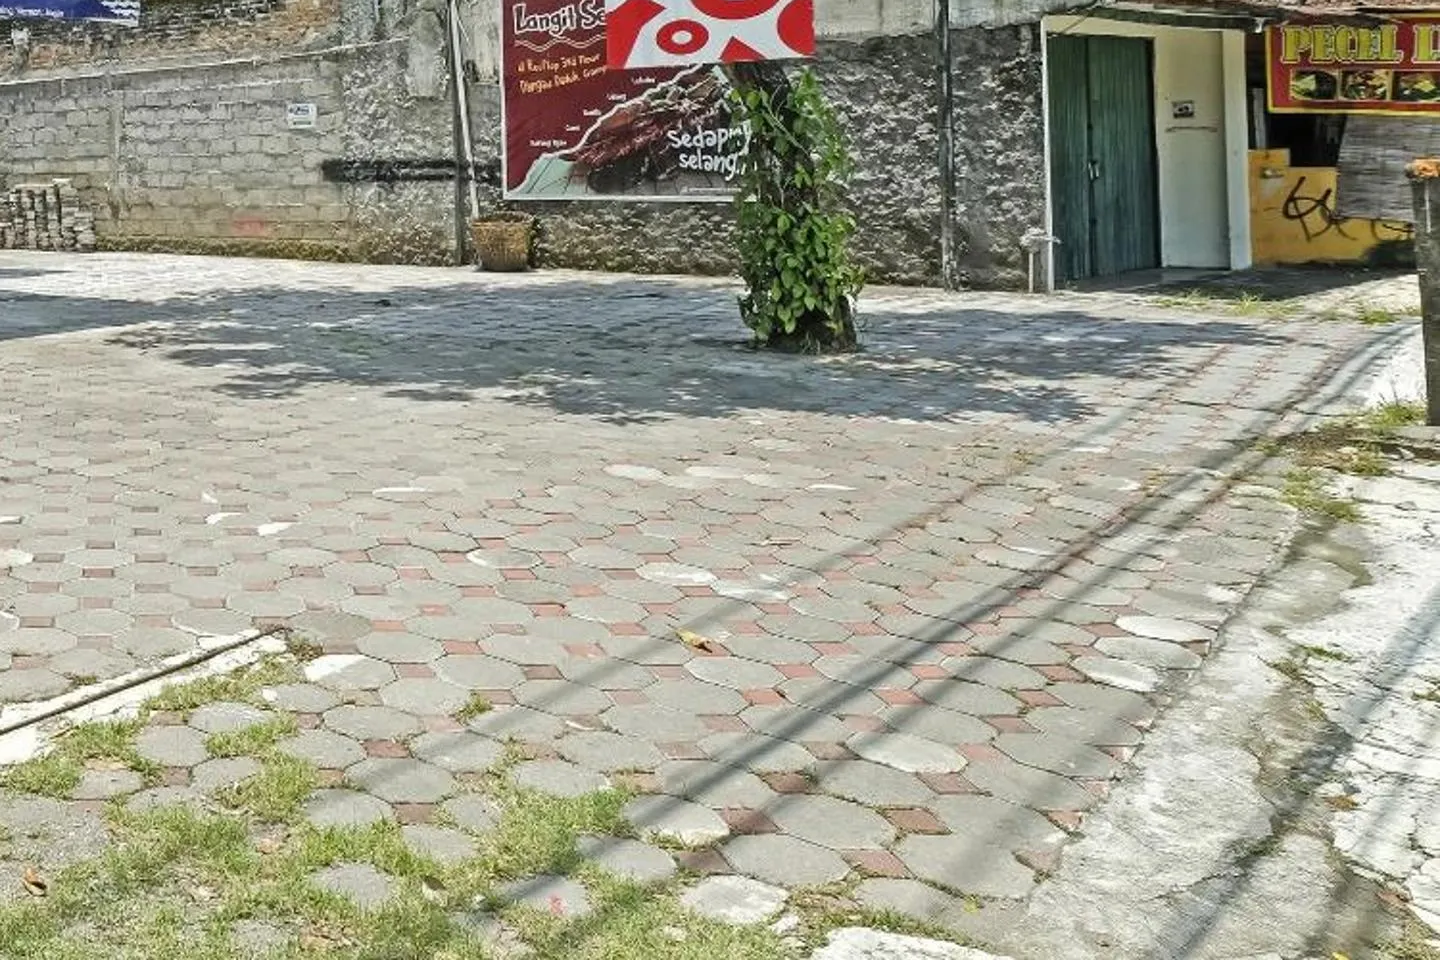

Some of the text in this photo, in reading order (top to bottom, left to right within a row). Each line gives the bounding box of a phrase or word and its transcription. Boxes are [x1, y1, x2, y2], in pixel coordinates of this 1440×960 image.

[513, 2, 576, 39] Langit
[1280, 24, 1440, 64] PECEL L
